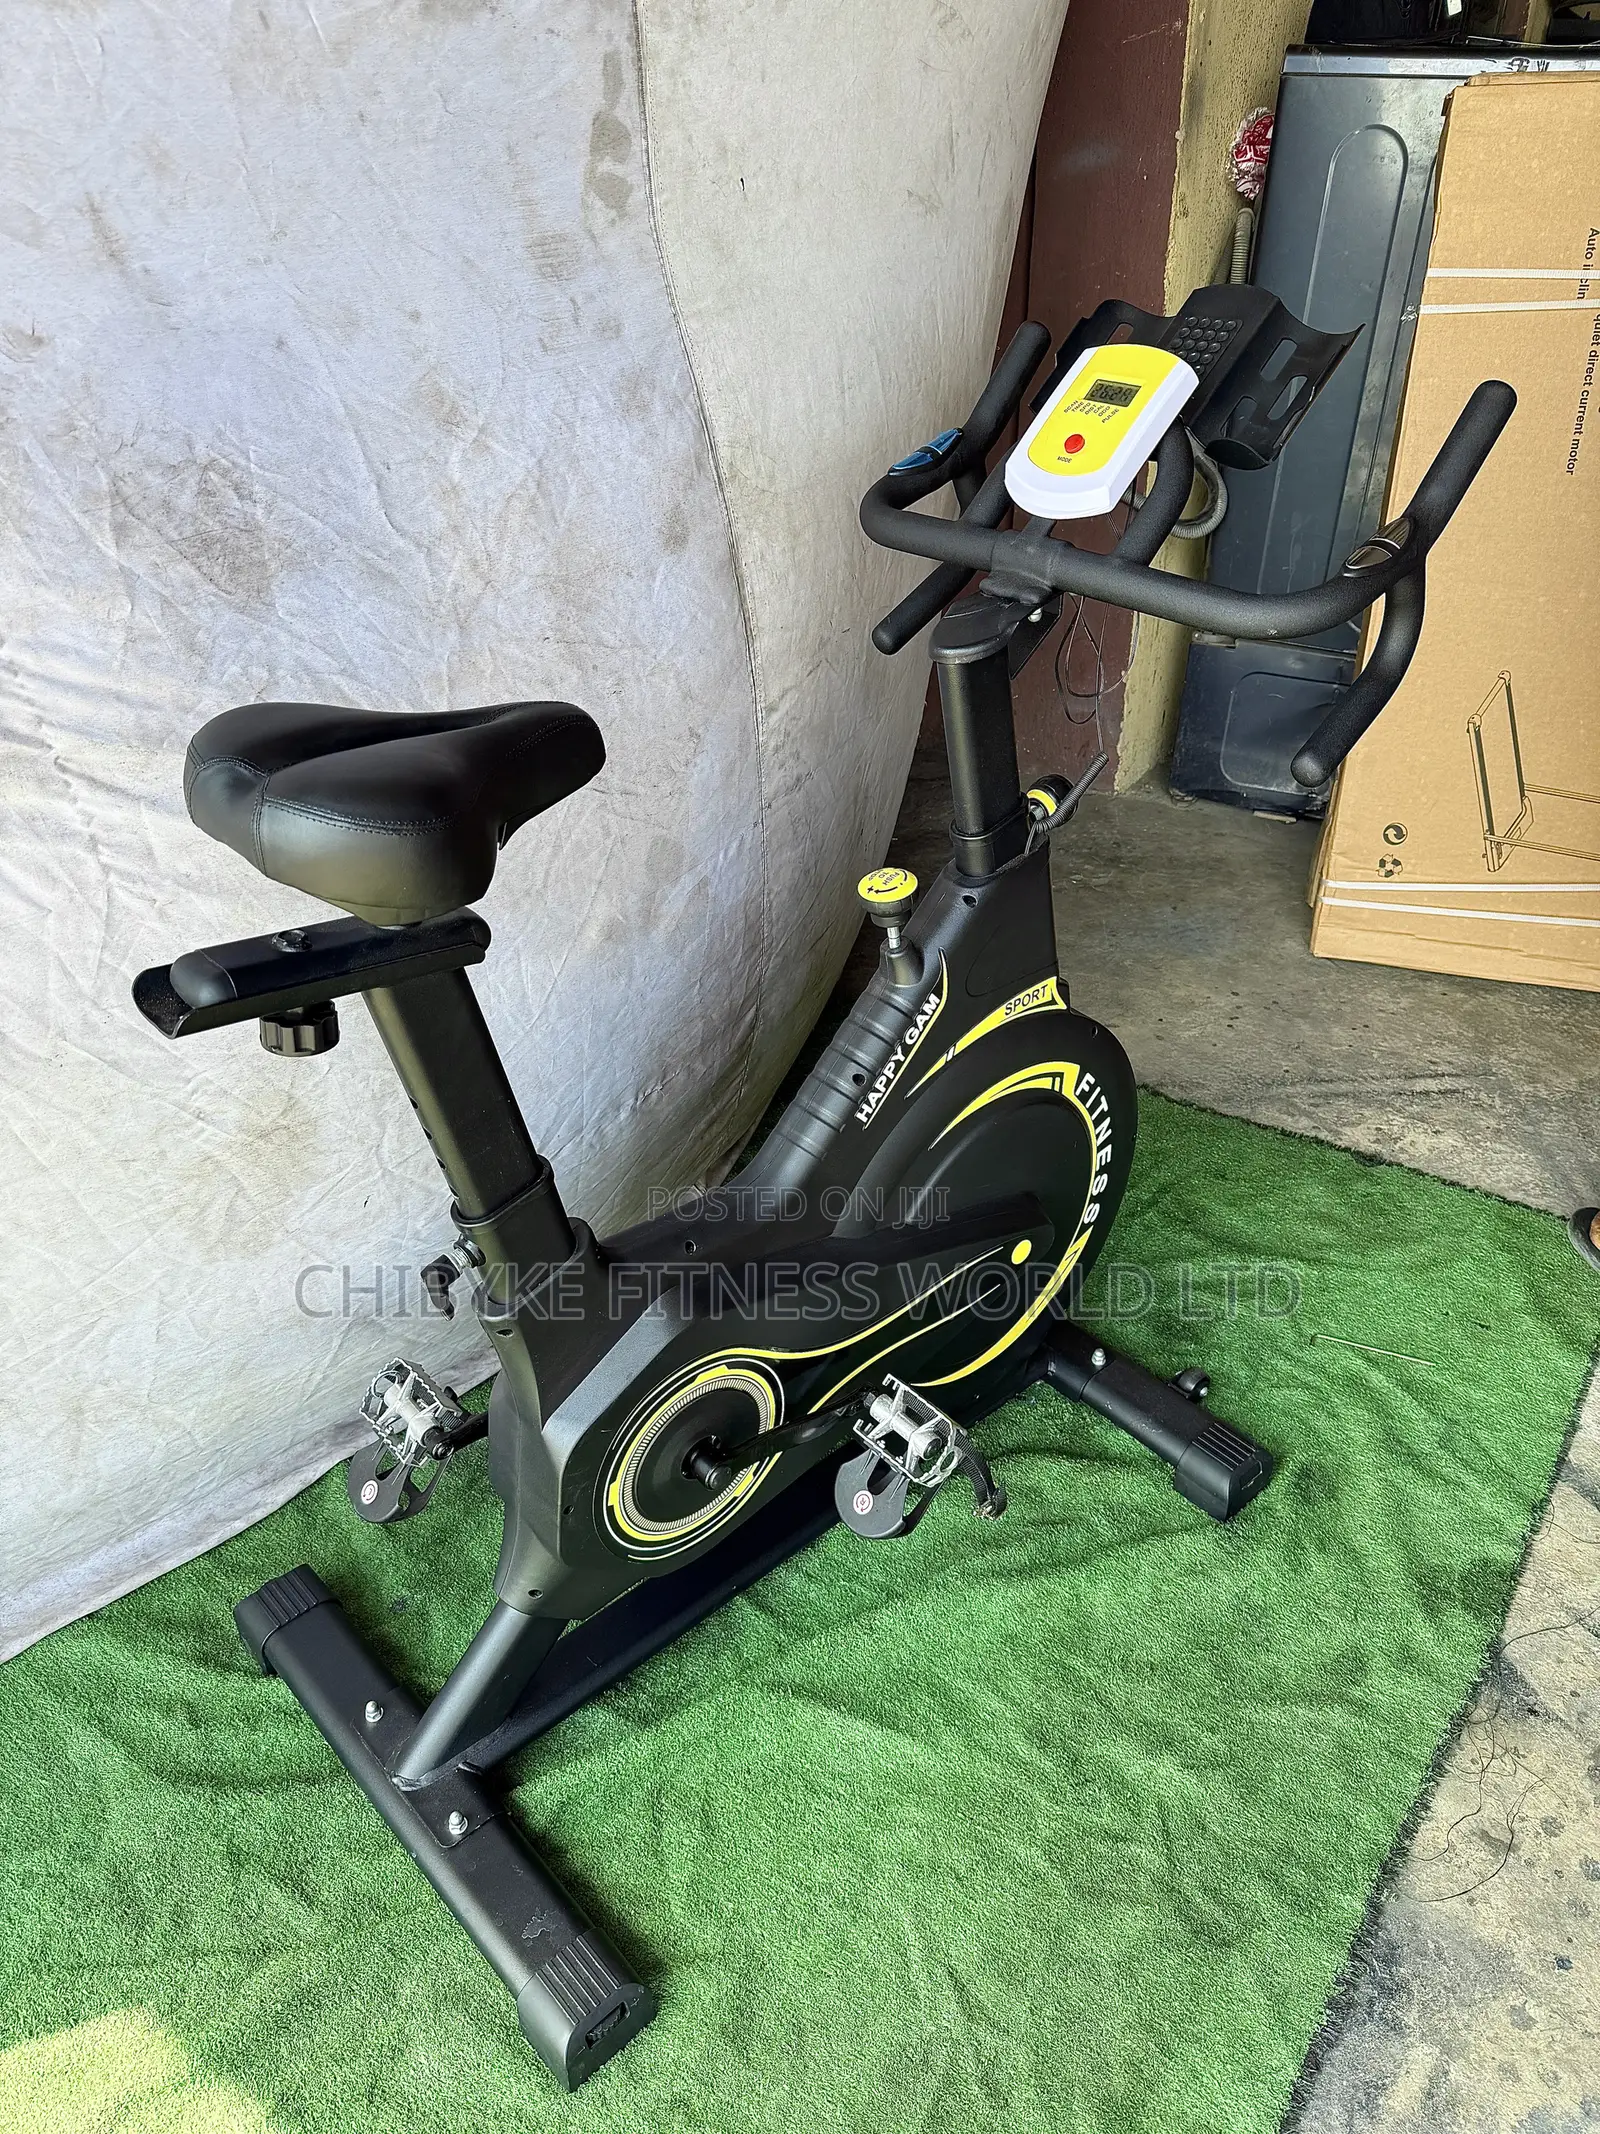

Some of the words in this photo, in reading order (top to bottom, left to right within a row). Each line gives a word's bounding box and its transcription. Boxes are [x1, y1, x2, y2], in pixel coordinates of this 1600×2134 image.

[1585, 228, 1600, 260] Auto
[1583, 350, 1599, 387] direct
[1063, 399, 1079, 413] SCAN
[1071, 401, 1084, 412] TIME
[1085, 404, 1097, 415] DIST
[1098, 406, 1111, 417] ODO
[1101, 408, 1120, 424] PULSE
[1573, 390, 1590, 436] current
[1566, 438, 1580, 476] motor
[882, 871, 900, 886] PUSH
[1003, 984, 1049, 1016] SPORT
[854, 1045, 906, 1123] HAPPY
[904, 993, 941, 1045] GAM
[1075, 1072, 1113, 1225] FITNESS
